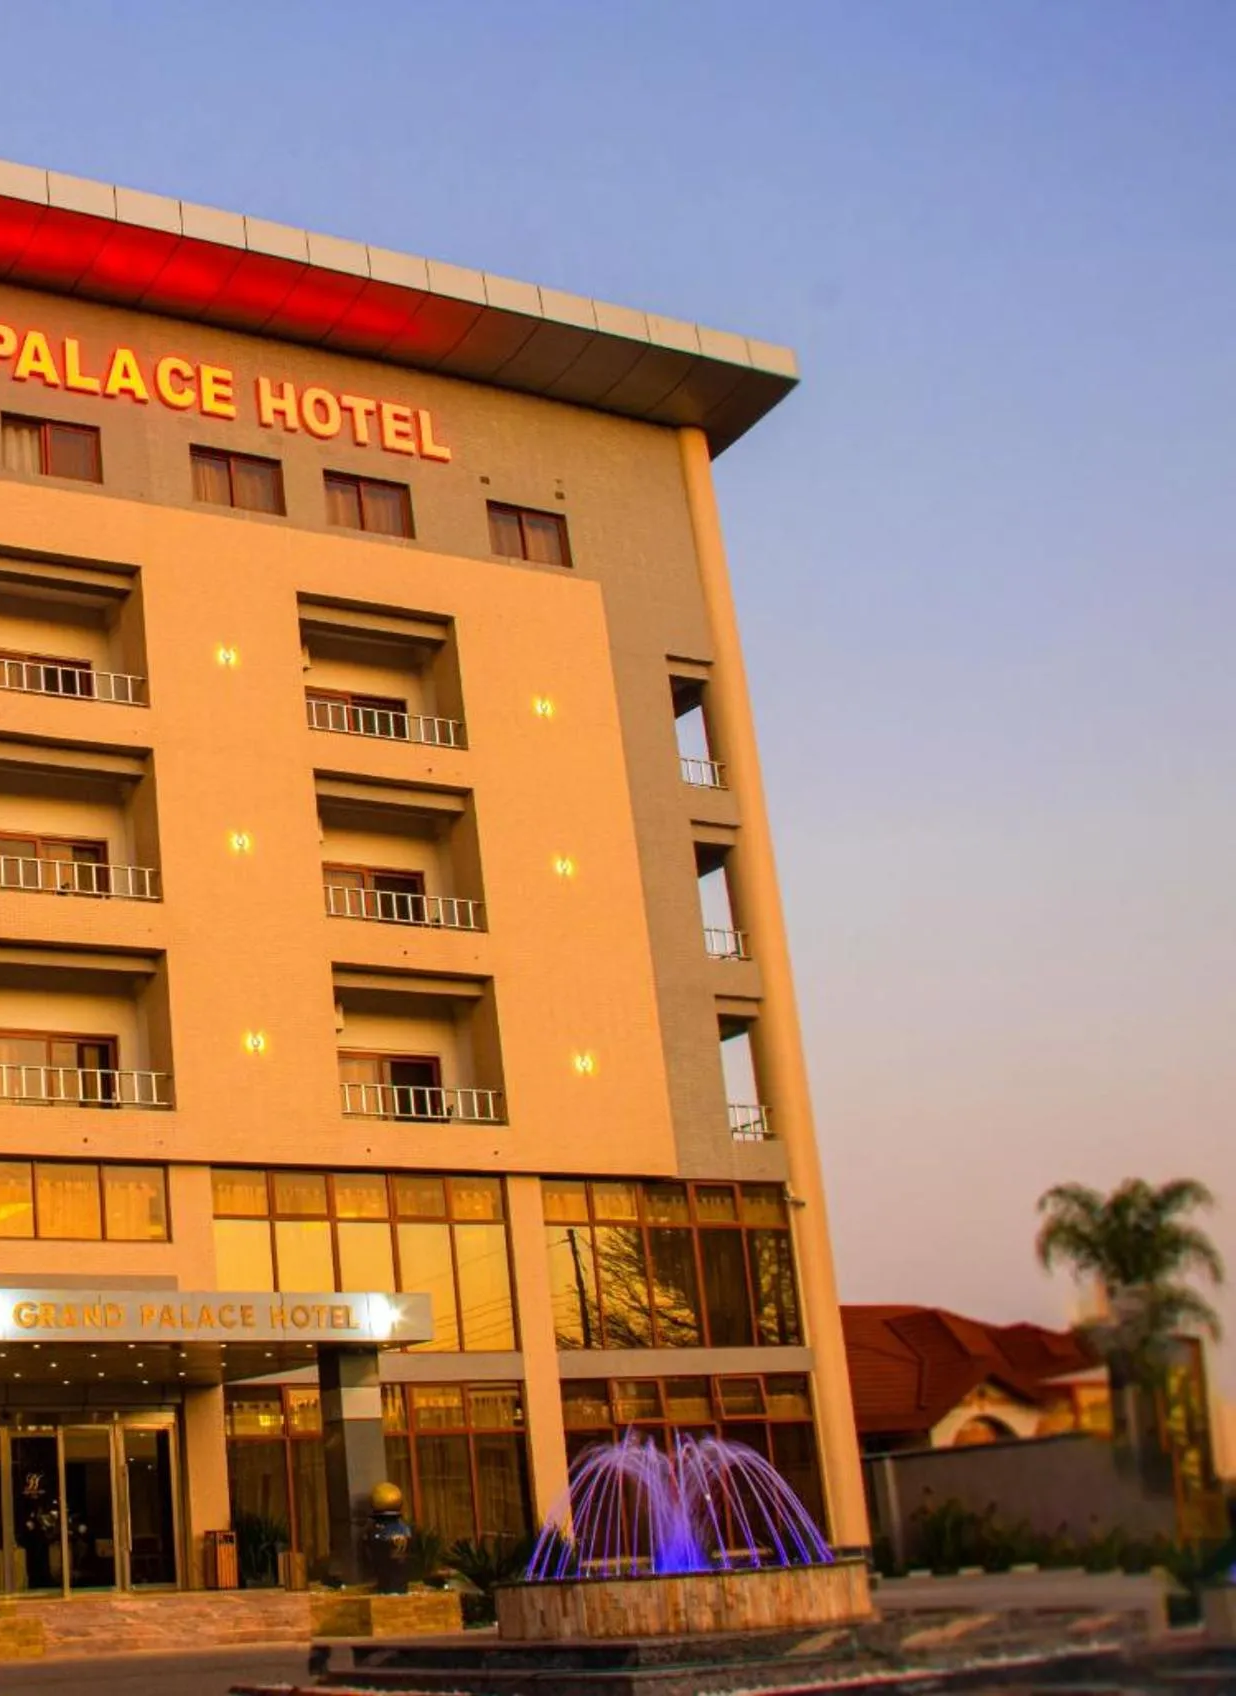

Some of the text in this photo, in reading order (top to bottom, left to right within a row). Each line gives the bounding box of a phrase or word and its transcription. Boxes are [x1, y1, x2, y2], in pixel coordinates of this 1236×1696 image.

[258, 376, 452, 463] HOTEL
[13, 1301, 359, 1330] GRAND PALACE HOTEL
